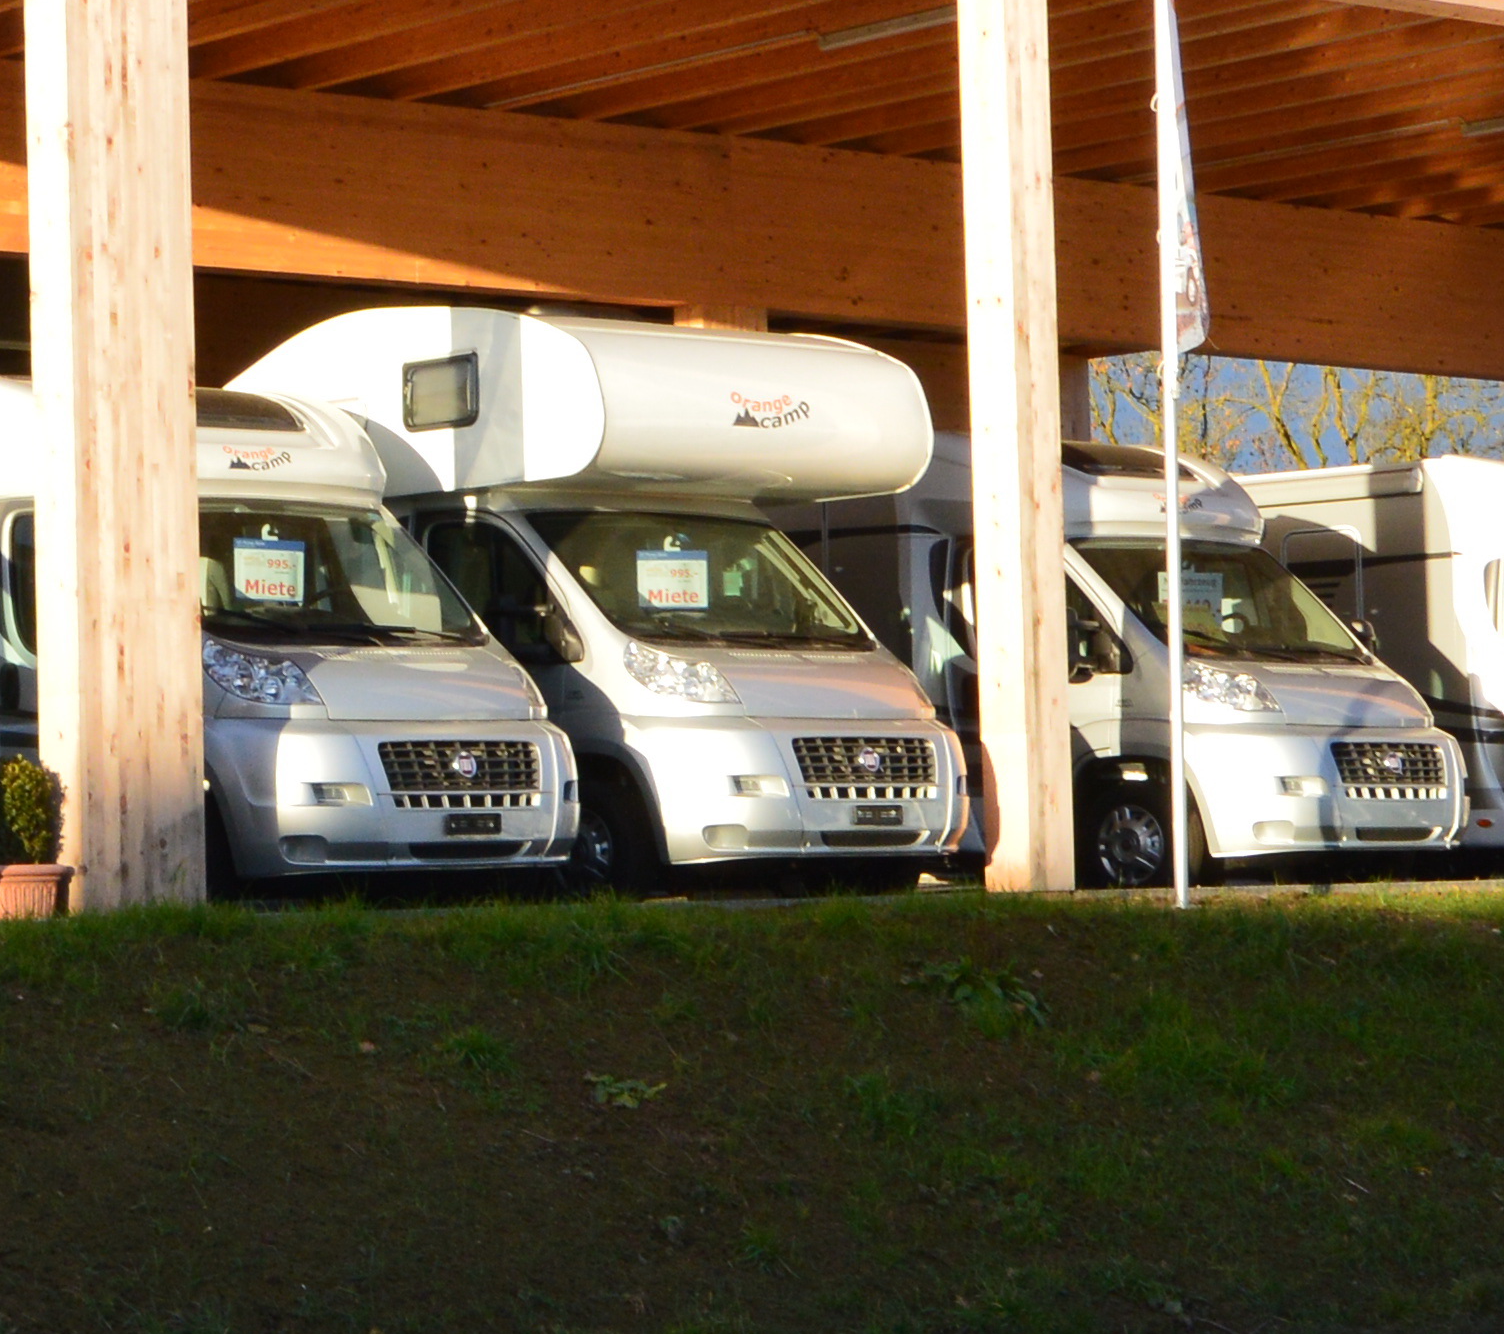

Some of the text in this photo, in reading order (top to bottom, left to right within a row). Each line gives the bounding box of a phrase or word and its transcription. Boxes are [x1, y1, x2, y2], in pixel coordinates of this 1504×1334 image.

[730, 391, 794, 415] orange
[760, 401, 810, 428] camp
[252, 451, 293, 471] camp
[245, 578, 297, 597] Miete
[647, 589, 700, 603] Miete
